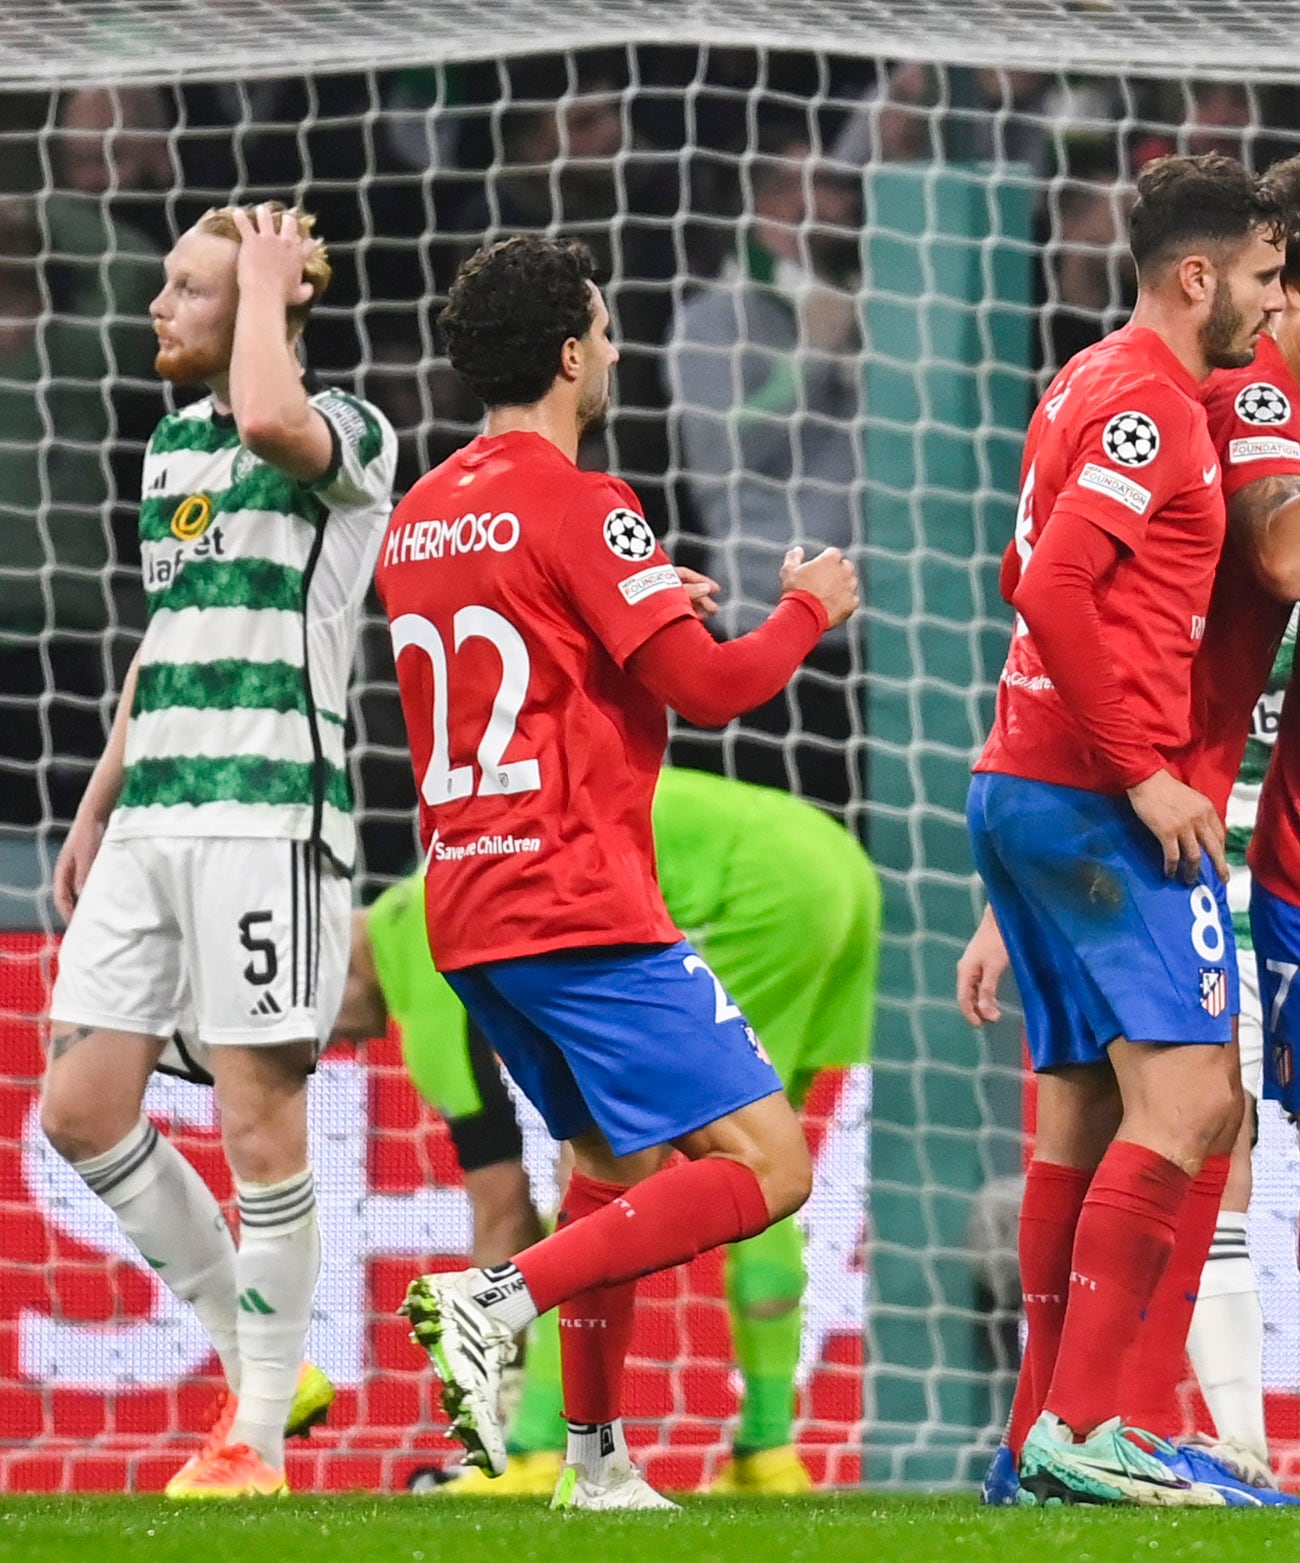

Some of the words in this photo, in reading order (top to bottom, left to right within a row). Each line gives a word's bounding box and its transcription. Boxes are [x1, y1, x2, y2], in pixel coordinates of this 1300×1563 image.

[1084, 470, 1147, 506] FOUNDATION
[389, 604, 541, 807] 22
[435, 842, 465, 861] Save
[477, 834, 541, 855] Children
[238, 910, 278, 986] 5
[1190, 884, 1226, 962] 8
[1266, 958, 1299, 1033] 7
